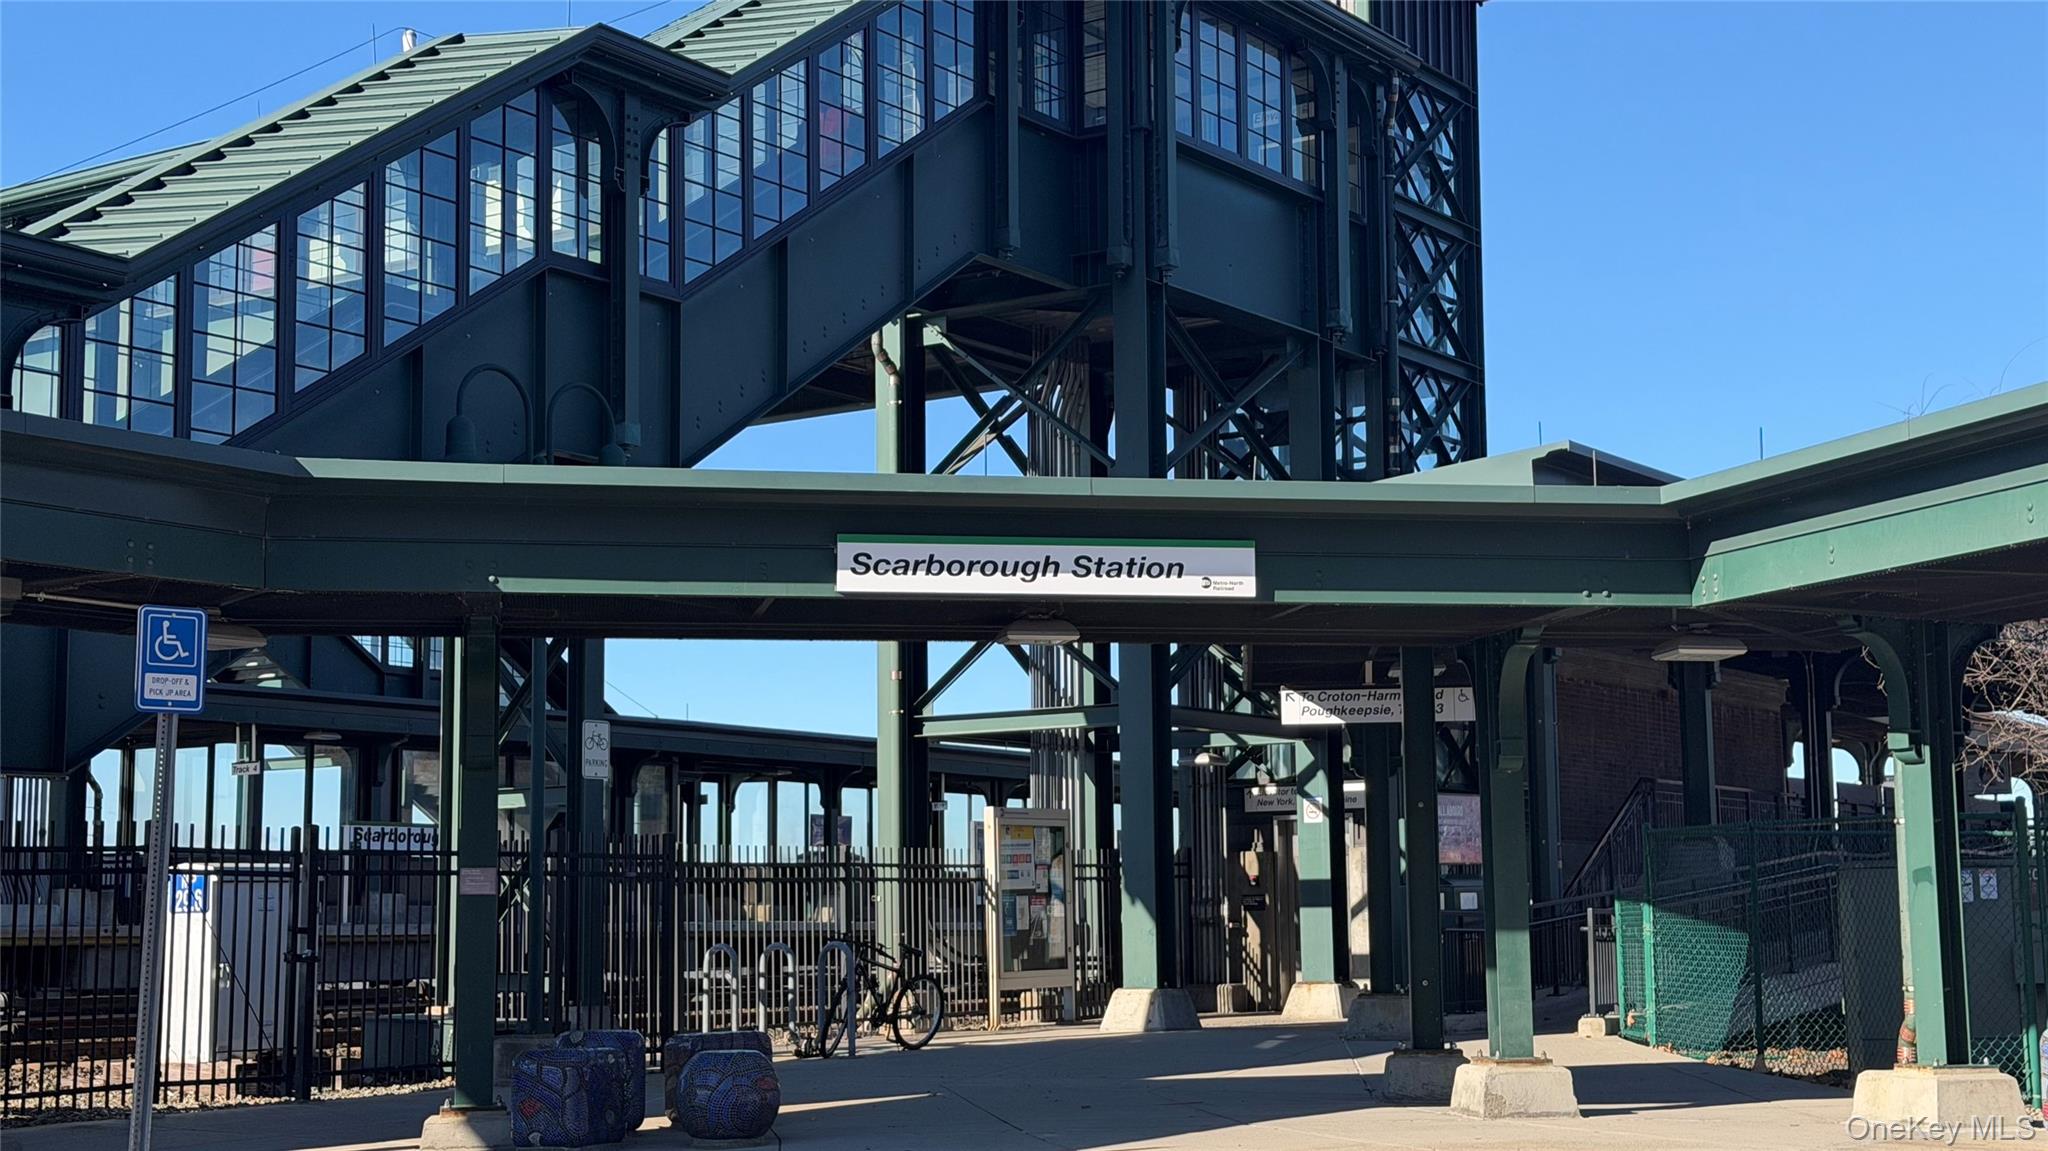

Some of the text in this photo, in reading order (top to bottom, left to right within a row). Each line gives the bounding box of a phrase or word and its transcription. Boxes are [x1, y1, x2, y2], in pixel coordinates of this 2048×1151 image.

[850, 552, 1184, 583] Scarborough Station
[149, 688, 163, 696] PICK
[1302, 690, 1401, 702] To Croton-Harm
[1302, 704, 1394, 719] Poughkeepsie,
[232, 764, 258, 774] Track 4
[1257, 798, 1274, 806] New
[1345, 795, 1357, 803] ine
[353, 826, 438, 847] Scarboroug
